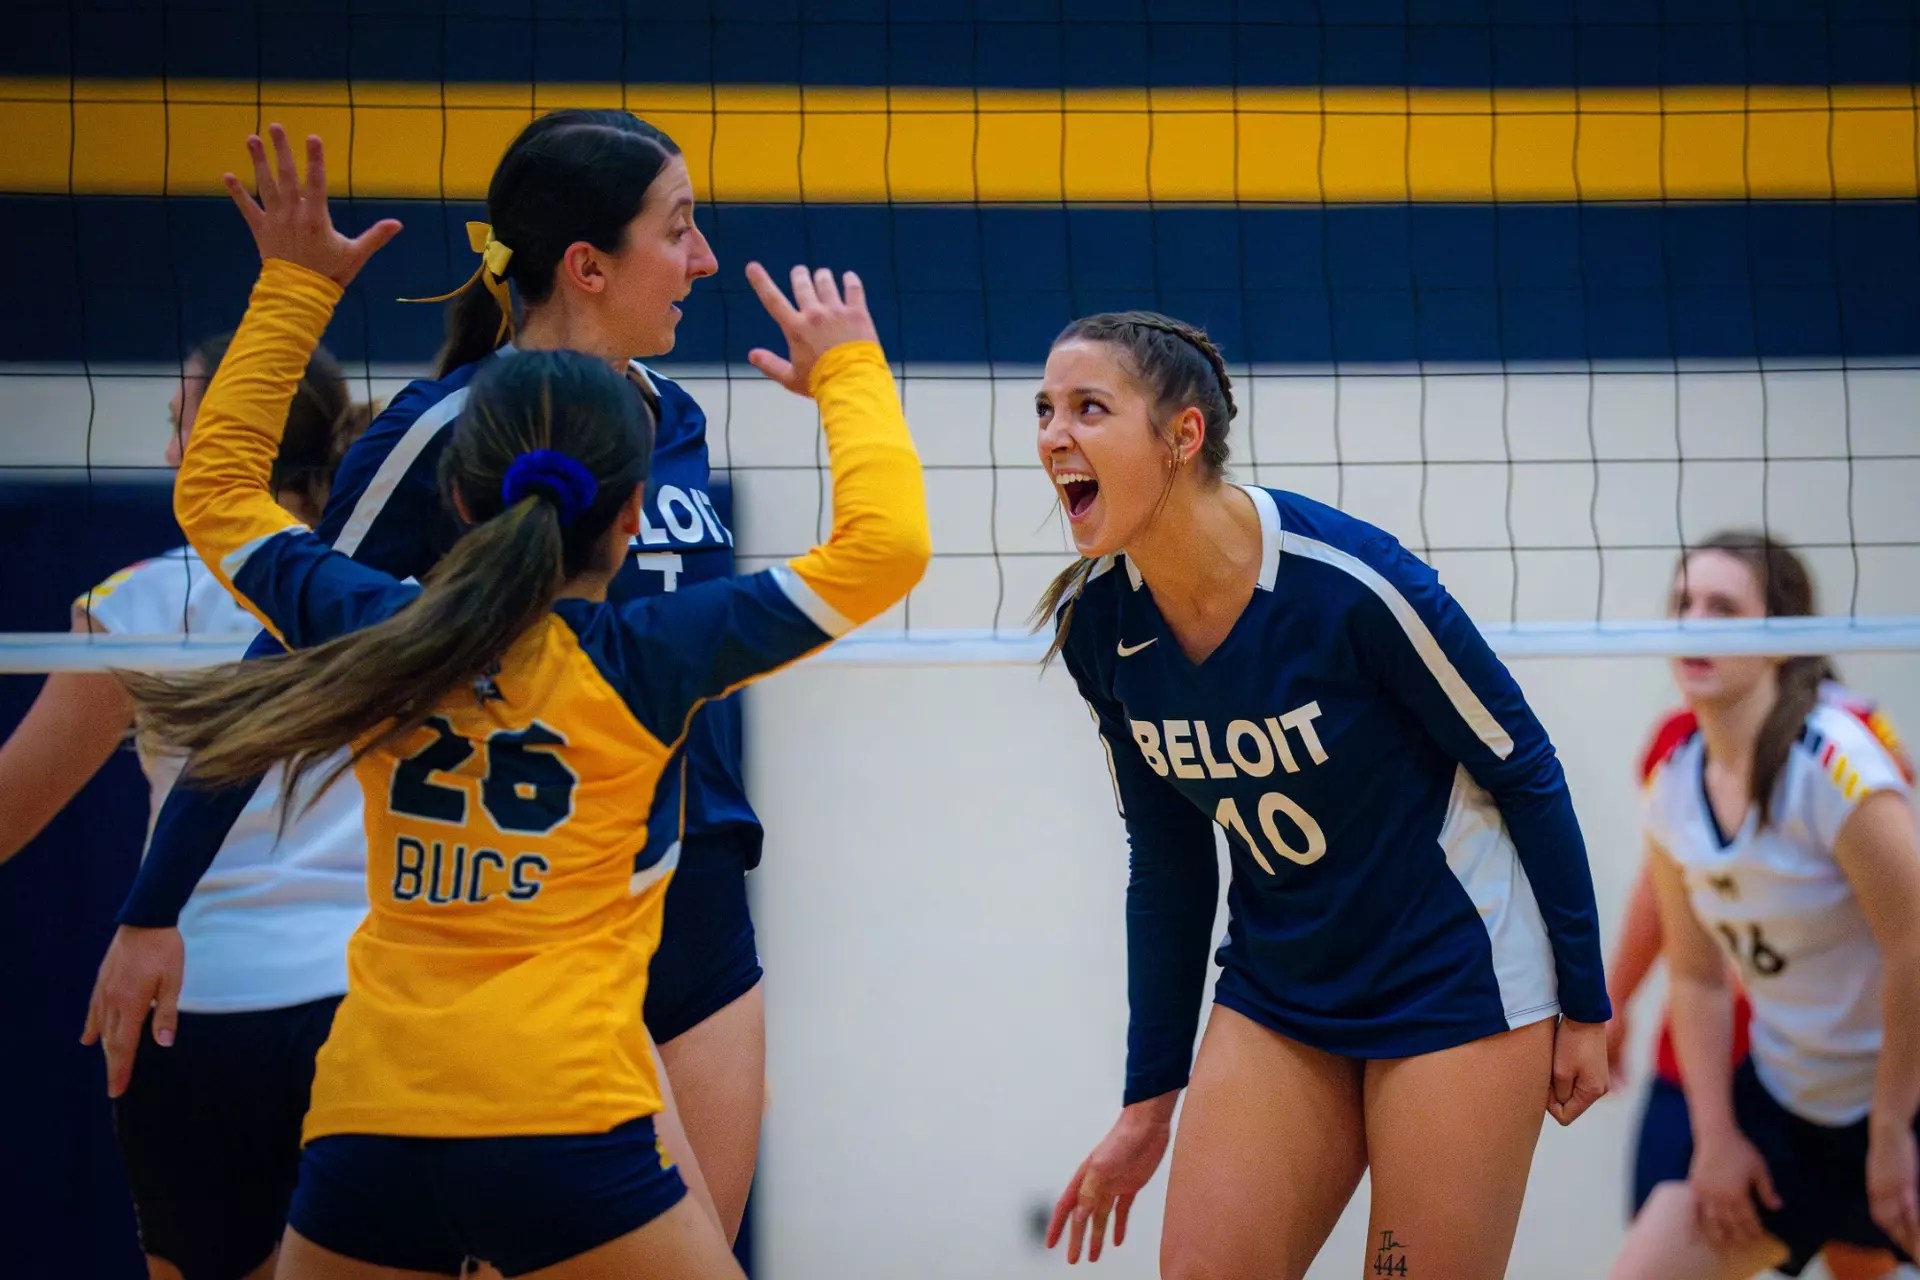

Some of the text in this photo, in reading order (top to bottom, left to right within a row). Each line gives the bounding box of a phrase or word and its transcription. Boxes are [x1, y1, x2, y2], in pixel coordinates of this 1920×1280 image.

[389, 715, 580, 836] 26
[1129, 700, 1329, 779] BELOIT
[393, 834, 549, 906] BUCS
[1215, 791, 1327, 875] 10
[1373, 1253, 1408, 1277] 444
